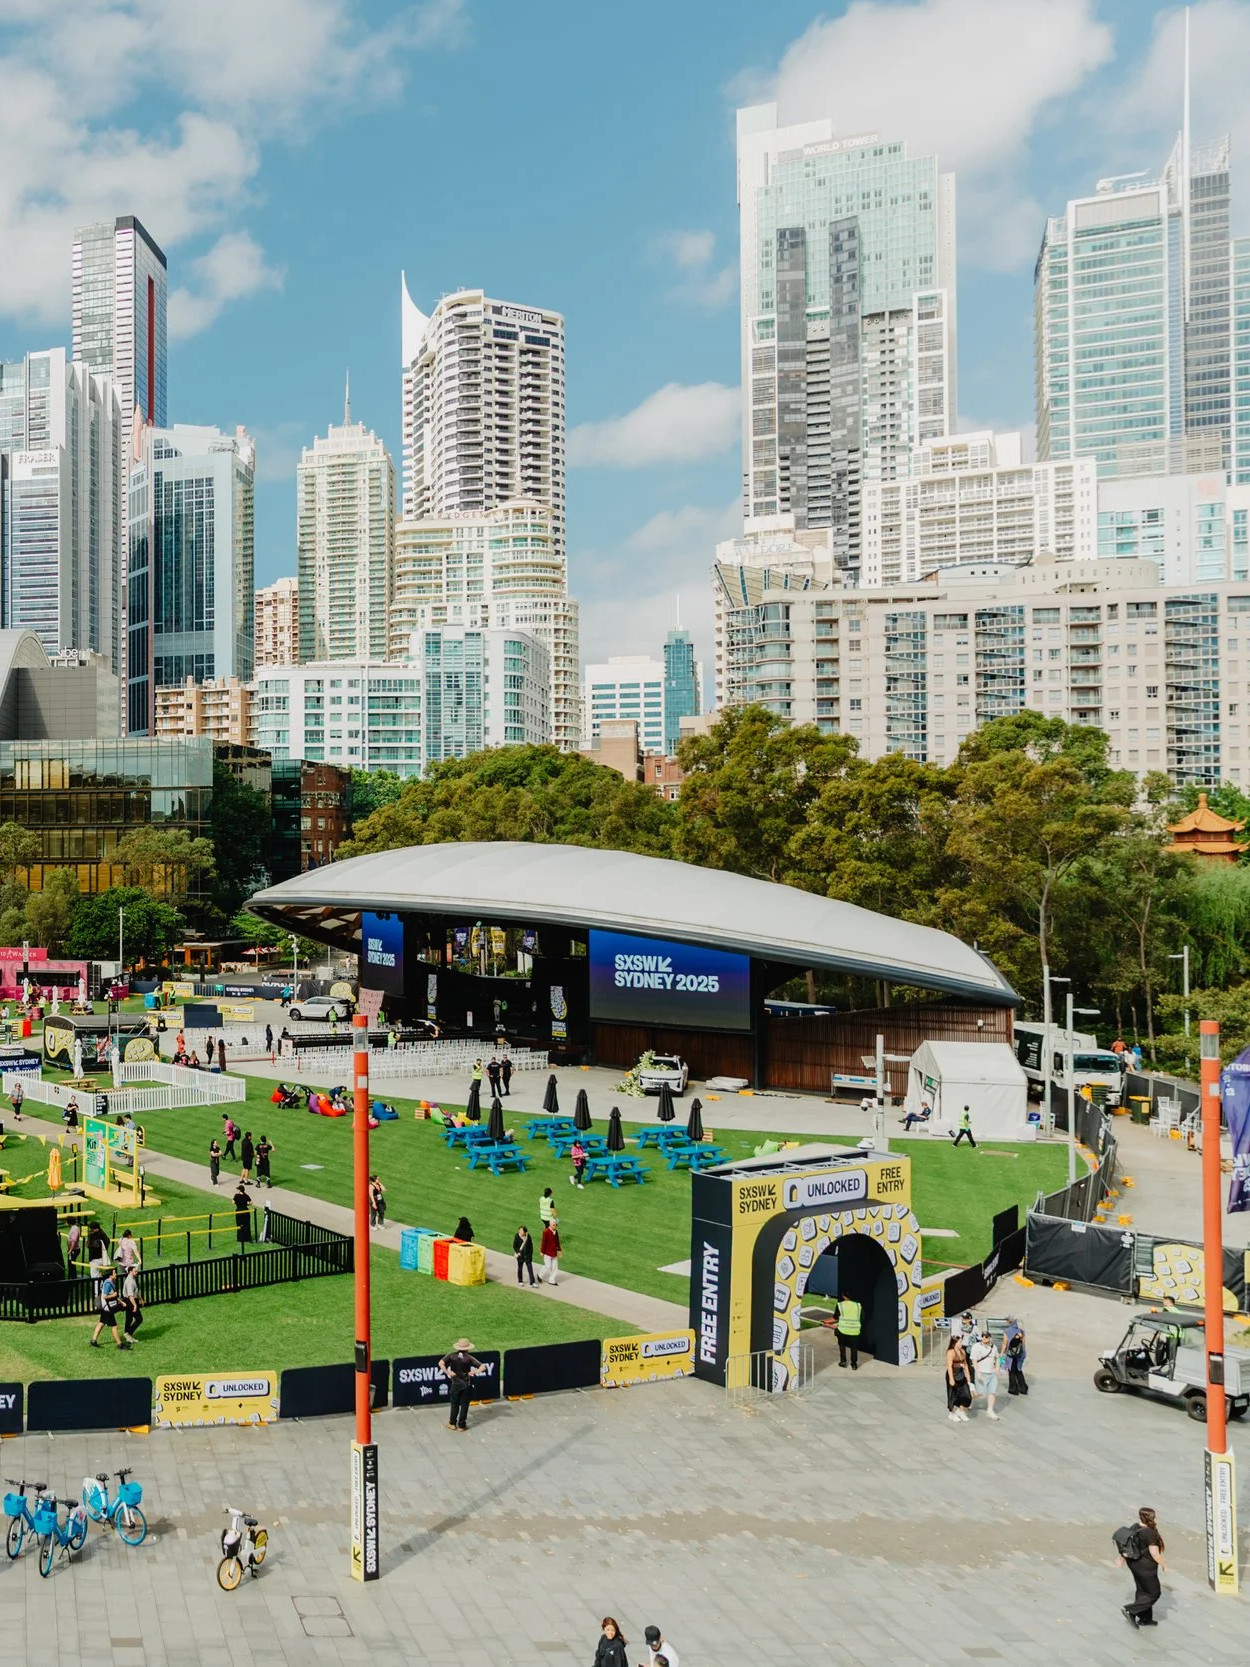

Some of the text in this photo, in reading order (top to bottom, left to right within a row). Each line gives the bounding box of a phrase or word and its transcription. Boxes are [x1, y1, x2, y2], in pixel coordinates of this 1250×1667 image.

[502, 305, 542, 324] MERITON
[437, 511, 484, 520] RYDGES
[614, 954, 657, 971] SXSW
[614, 972, 720, 992] SYDNEY 2025
[880, 1166, 901, 1179] FREE
[739, 1186, 767, 1200] SXSW
[807, 1178, 860, 1197] UNLOCKED
[877, 1179, 905, 1194] ENTRY
[739, 1197, 777, 1214] SYDNEY
[700, 1241, 720, 1365] FREE ENTRY
[610, 1344, 632, 1354] SXSW
[655, 1341, 686, 1351] UNLOCKED
[610, 1352, 639, 1363] SYDNEY
[399, 1367, 434, 1383] SXSW
[164, 1382, 191, 1392] SXSW
[223, 1383, 264, 1392] UNLOCKED
[164, 1391, 202, 1401] SYDNEY
[1219, 1467, 1227, 1486] ENTRY
[1205, 1487, 1214, 1535] SYDNEY
[365, 1481, 377, 1574] SXSW SYDNEY
